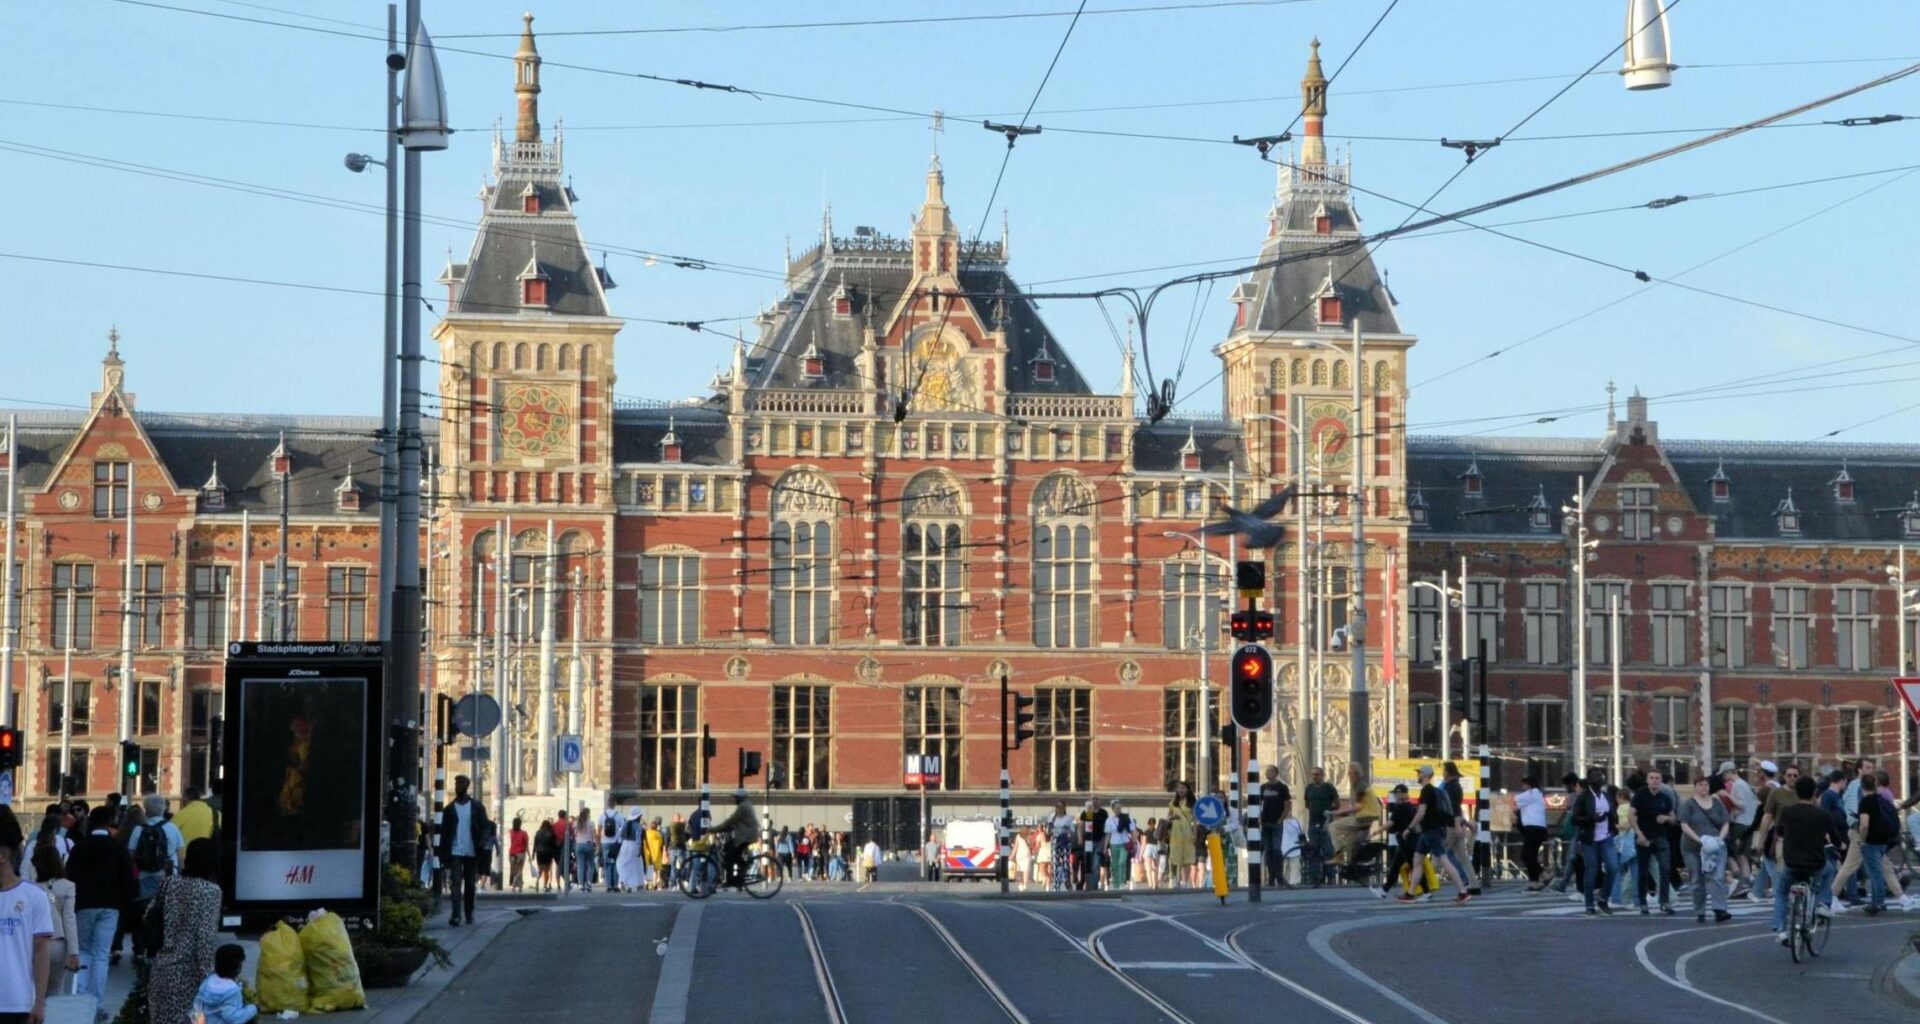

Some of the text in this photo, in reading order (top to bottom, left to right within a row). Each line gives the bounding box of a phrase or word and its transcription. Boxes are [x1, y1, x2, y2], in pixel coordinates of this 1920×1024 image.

[257, 644, 335, 655] Stadsplattegrond
[343, 643, 360, 655] City
[361, 645, 382, 655] map
[288, 668, 320, 676] JCDecaux
[908, 755, 920, 774] M
[925, 756, 939, 774] M
[284, 865, 314, 885] H&M
